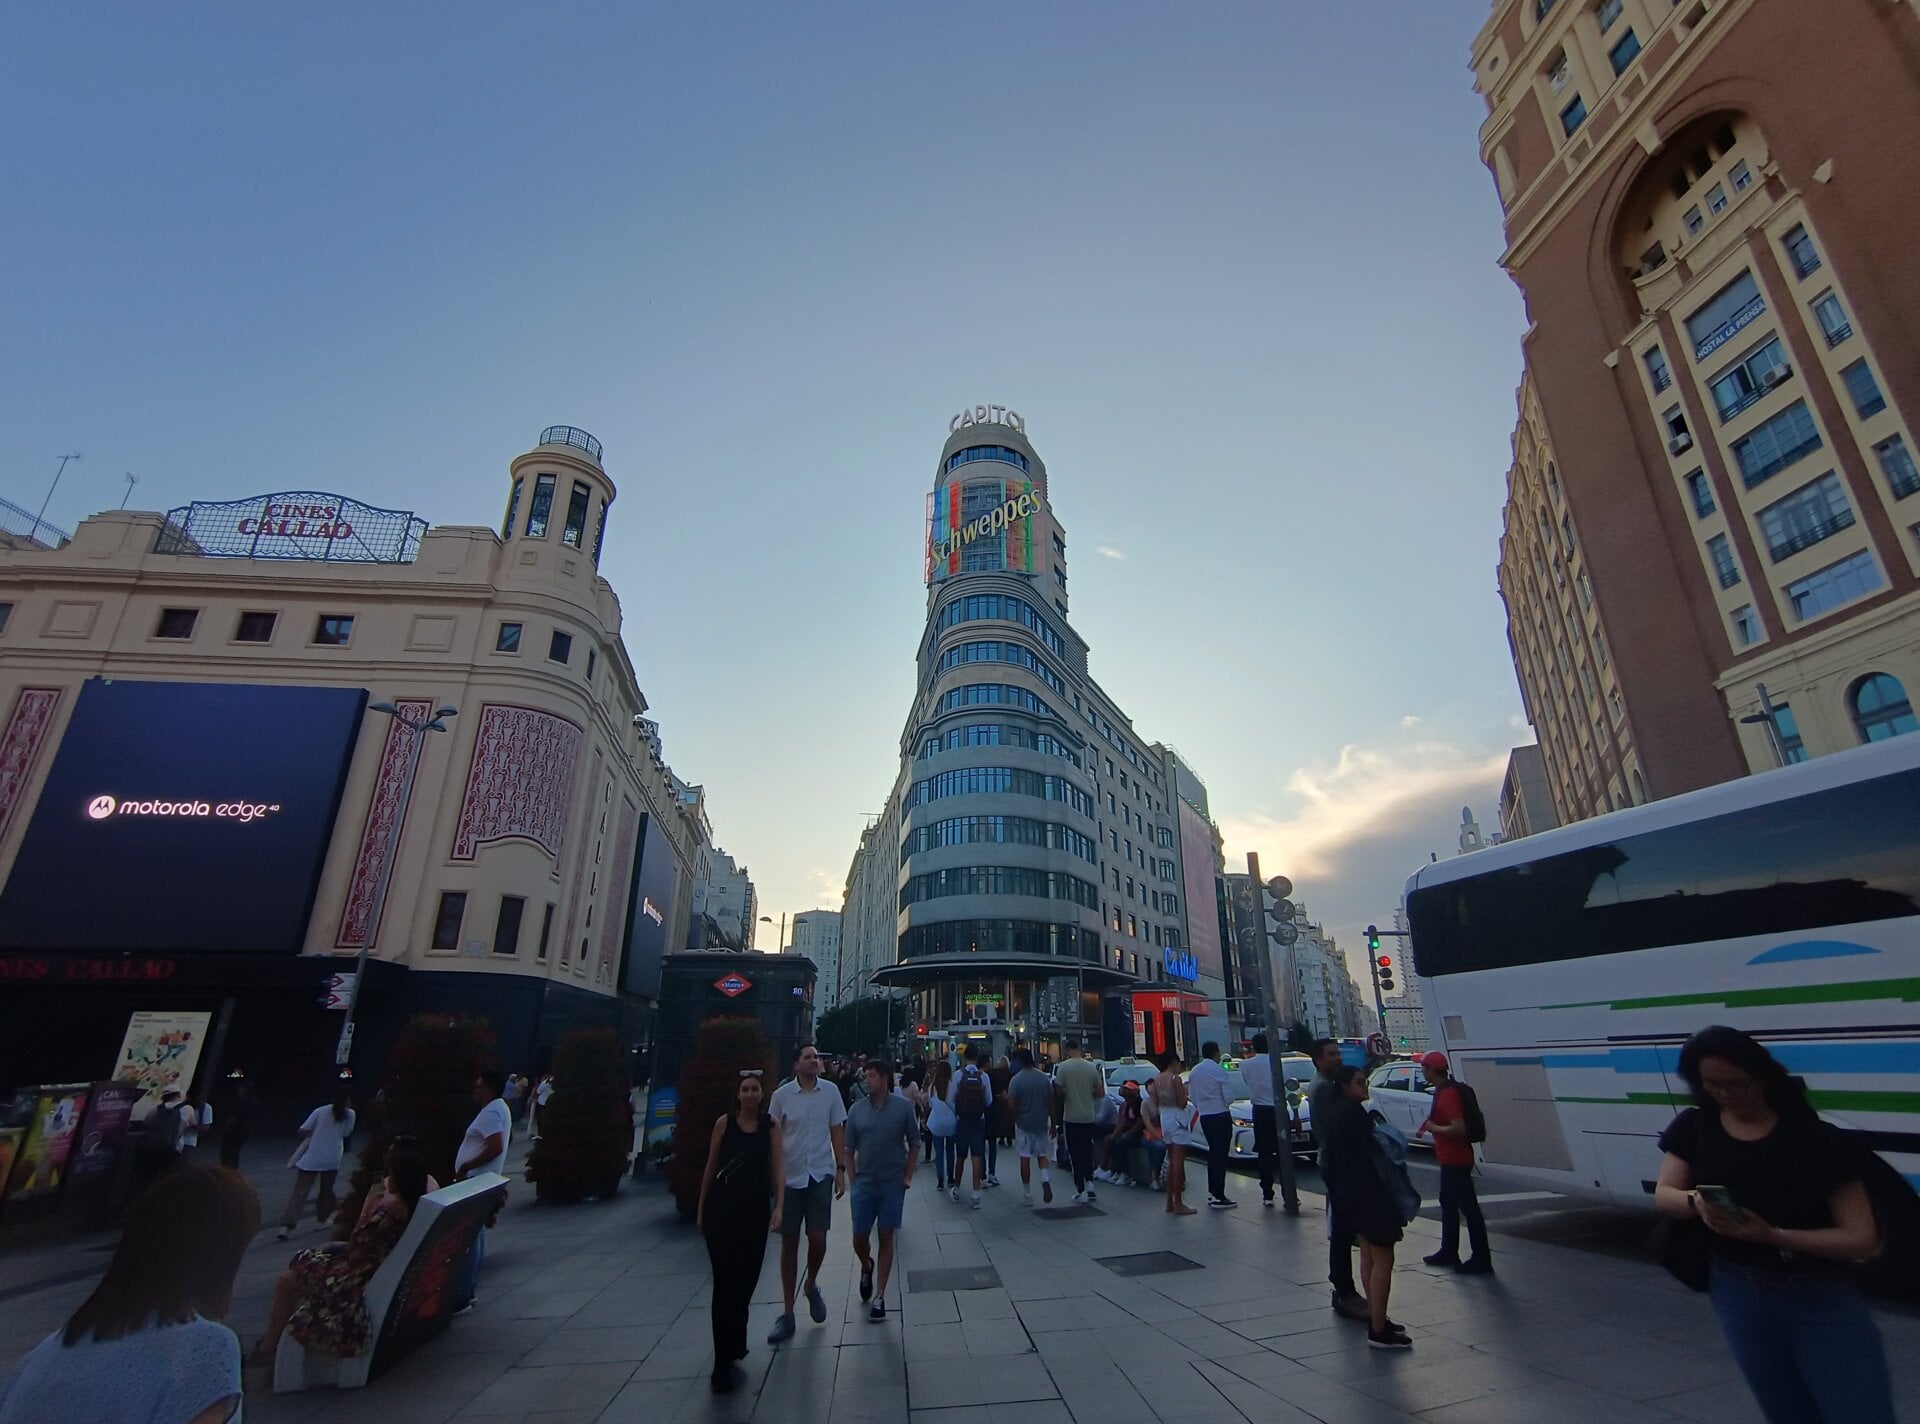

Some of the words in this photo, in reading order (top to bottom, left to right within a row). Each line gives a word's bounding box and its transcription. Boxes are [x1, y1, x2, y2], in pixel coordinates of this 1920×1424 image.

[1697, 334, 1726, 359] HOSTAL
[1725, 326, 1736, 337] LA
[1735, 301, 1766, 329] PRENSA
[267, 504, 336, 519] CINES
[238, 518, 353, 540] CALLAO
[929, 489, 1042, 574] Schweppes
[119, 800, 210, 816] motorola
[216, 801, 267, 822] edge
[66, 958, 176, 981] CALLAO
[1164, 946, 1199, 982] Caitol
